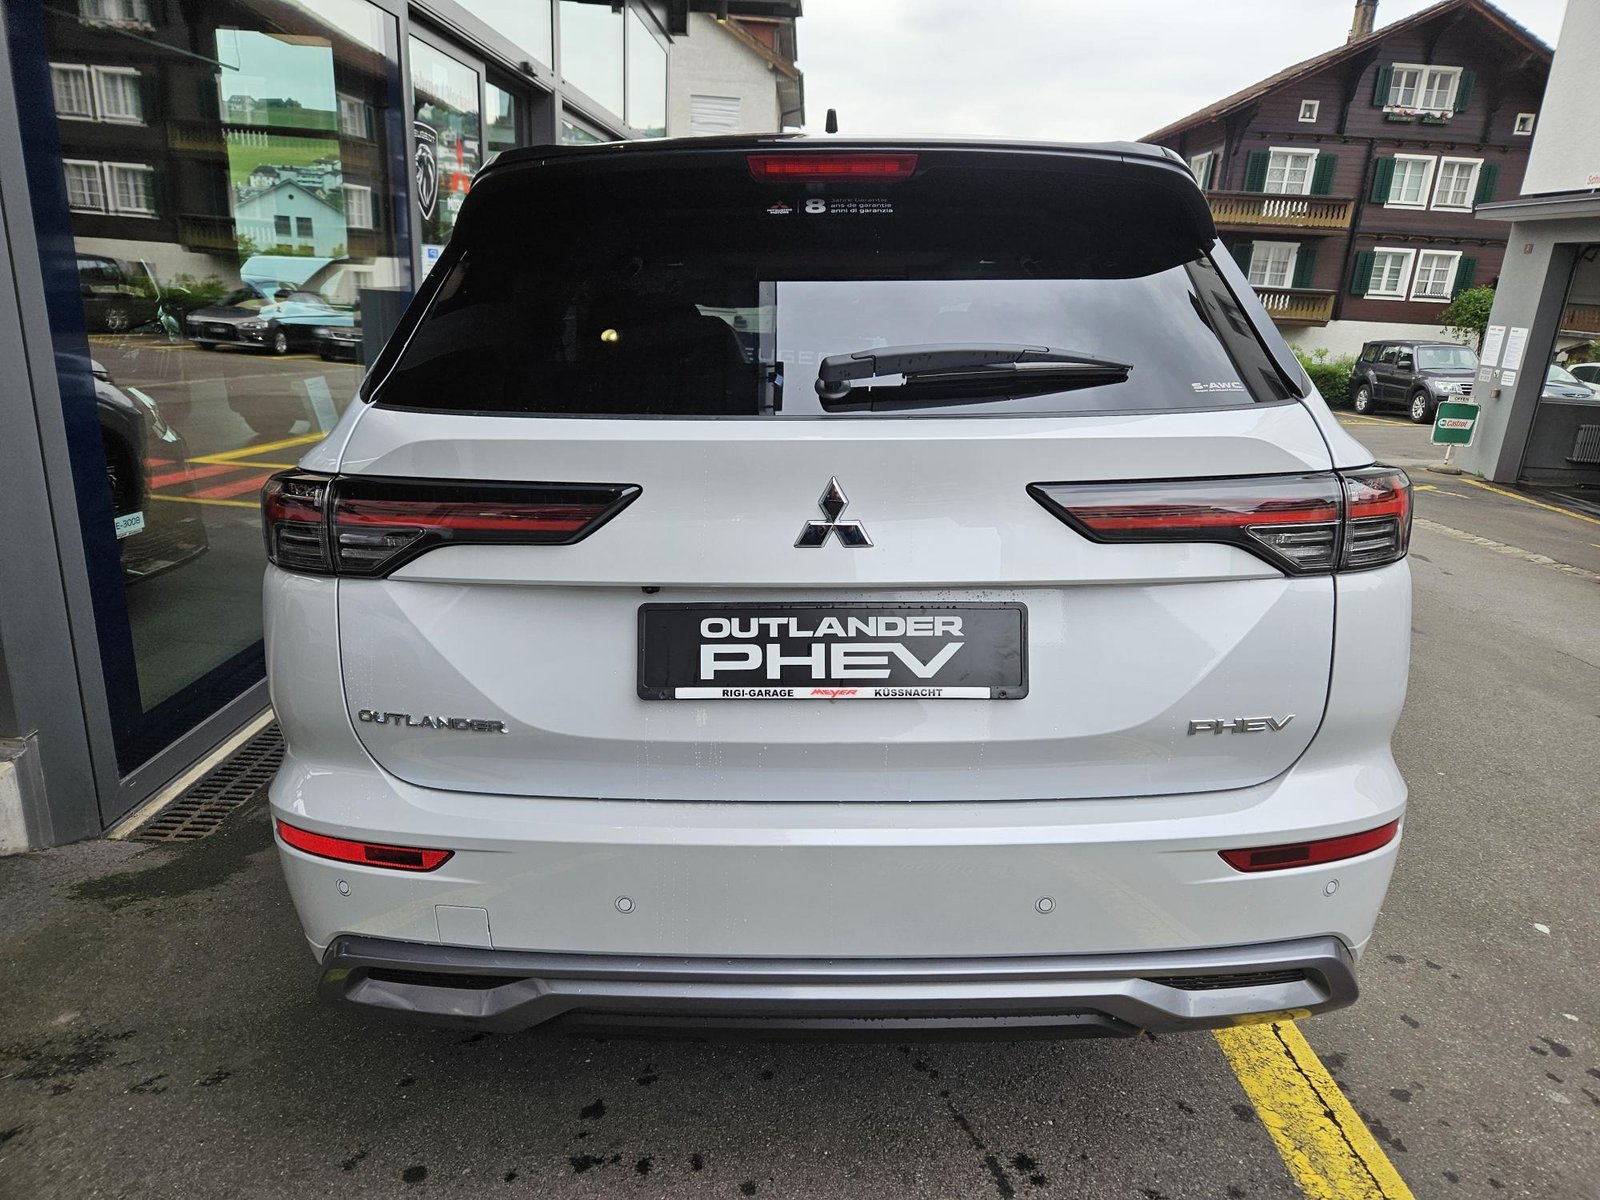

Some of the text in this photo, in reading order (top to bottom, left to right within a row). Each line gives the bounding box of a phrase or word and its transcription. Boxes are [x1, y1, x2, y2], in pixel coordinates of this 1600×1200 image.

[414, 128, 436, 142] EUGEOT
[805, 198, 826, 214] 8
[1191, 382, 1243, 390] S-AWC
[1446, 420, 1468, 428] Castrol
[700, 615, 964, 639] OUTLANDER
[700, 641, 965, 680] PHEV
[722, 689, 794, 698] RIGI-GARAGE
[874, 687, 943, 698] KÜSSNACHT
[358, 709, 509, 734] OUTLANDER
[1188, 714, 1296, 736] PHEV
